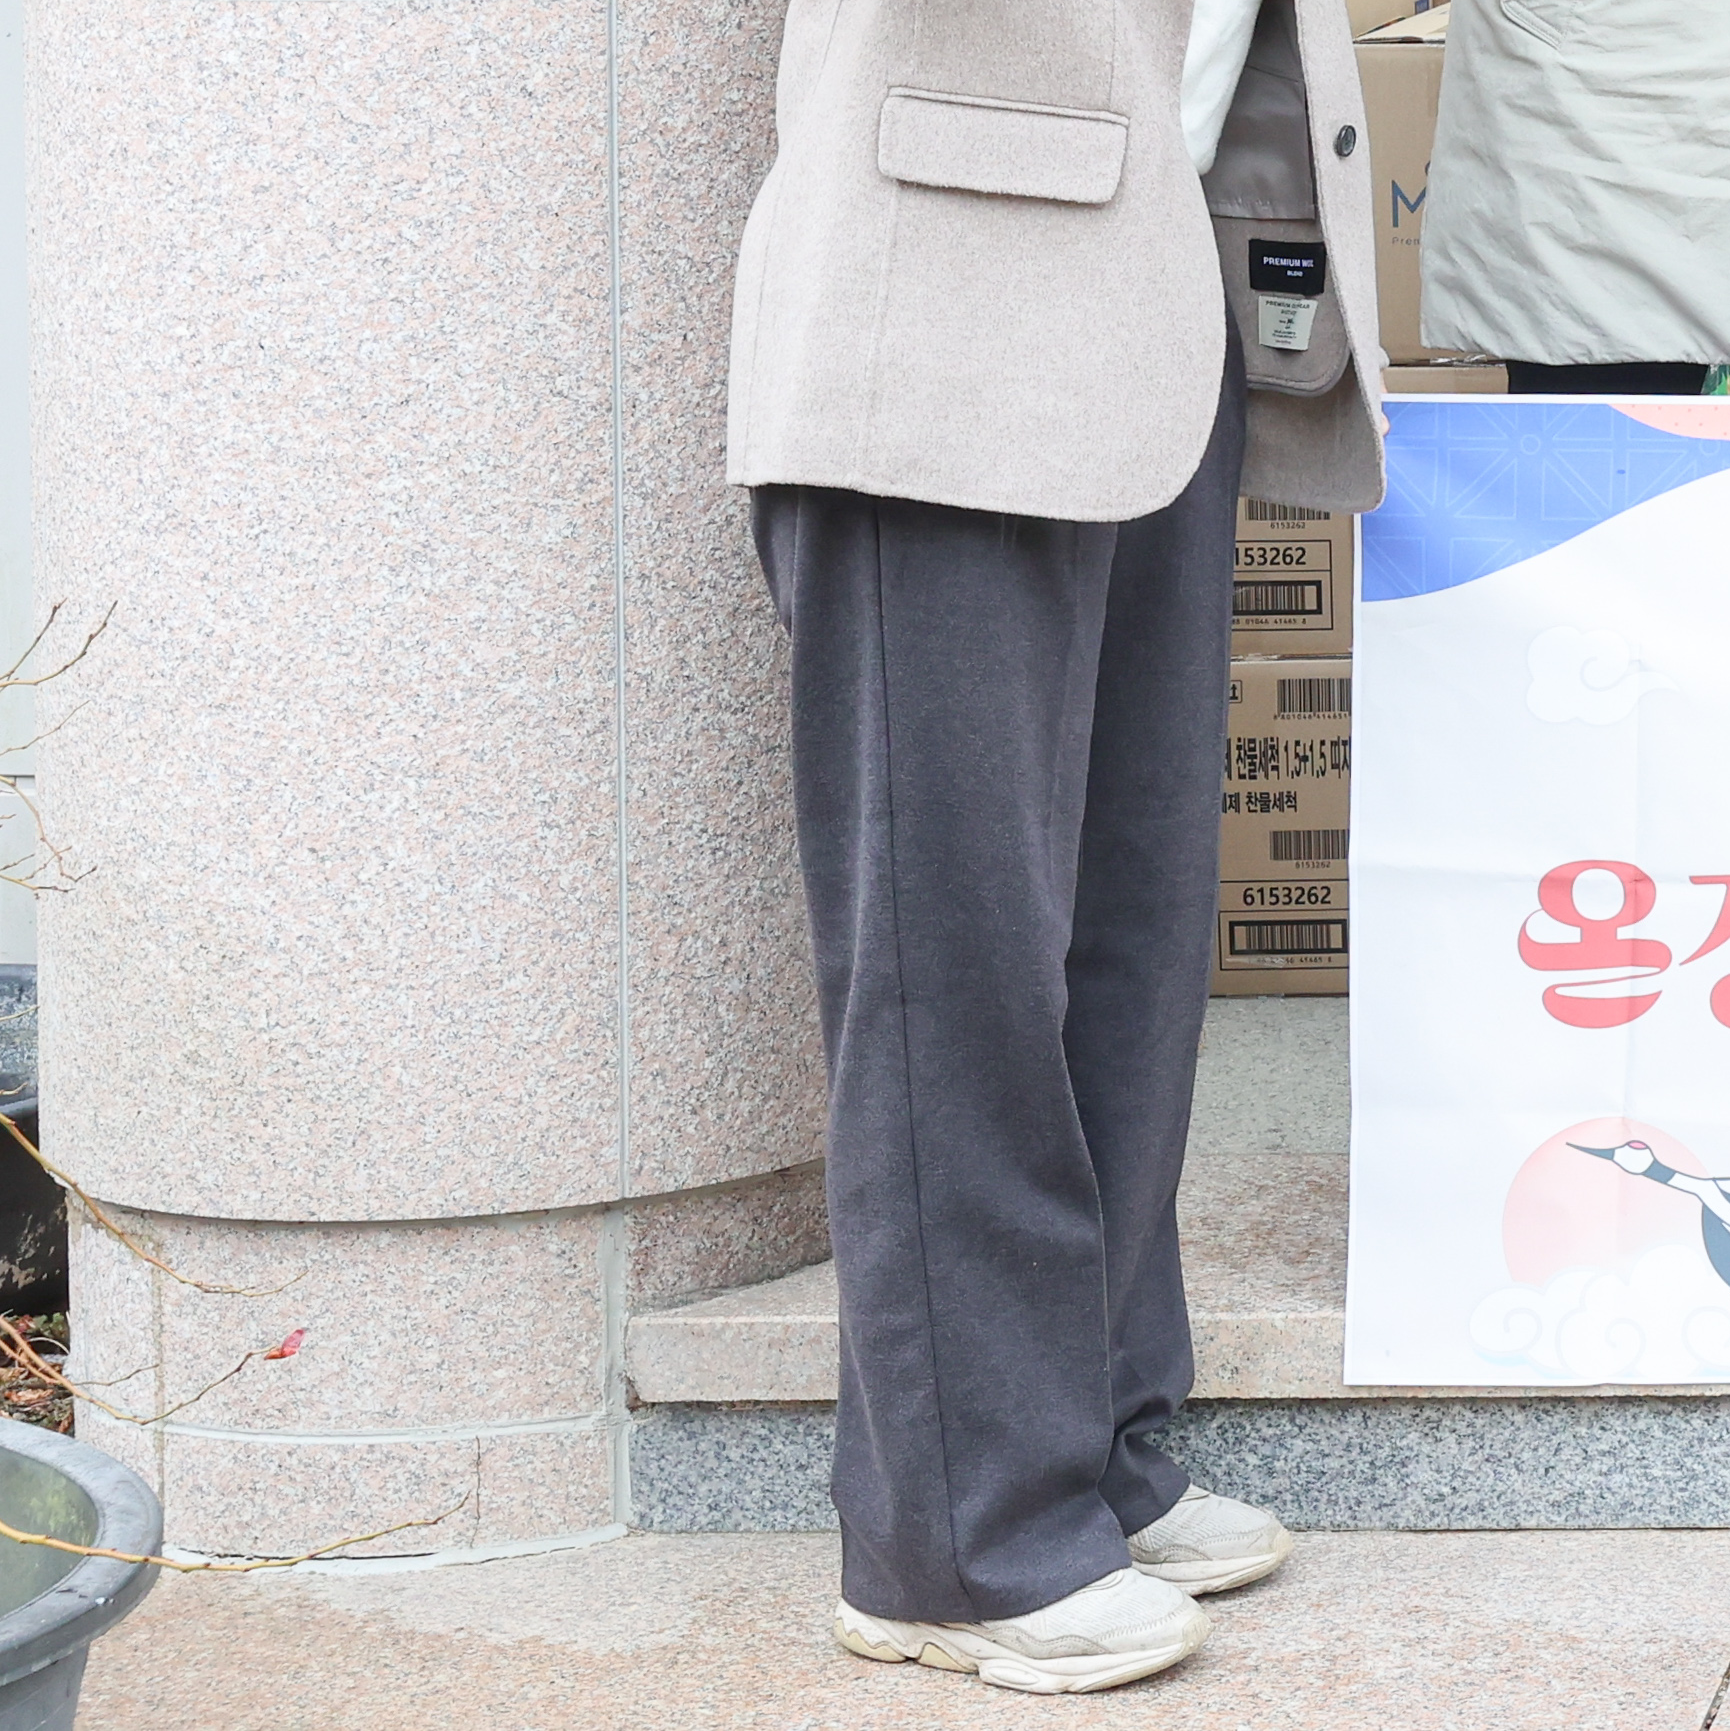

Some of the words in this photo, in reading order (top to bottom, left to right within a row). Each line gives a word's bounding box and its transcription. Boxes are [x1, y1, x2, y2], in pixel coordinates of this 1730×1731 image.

[1263, 256, 1301, 268] PREMIUM
[1270, 521, 1306, 530] 6153262
[1235, 546, 1307, 567] 153262
[1236, 736, 1281, 781] 찬물세척
[1221, 791, 1241, 814] 제
[1245, 790, 1298, 814] 찬물세척
[1295, 861, 1331, 869] 6153262
[1243, 885, 1332, 907] 6153262
